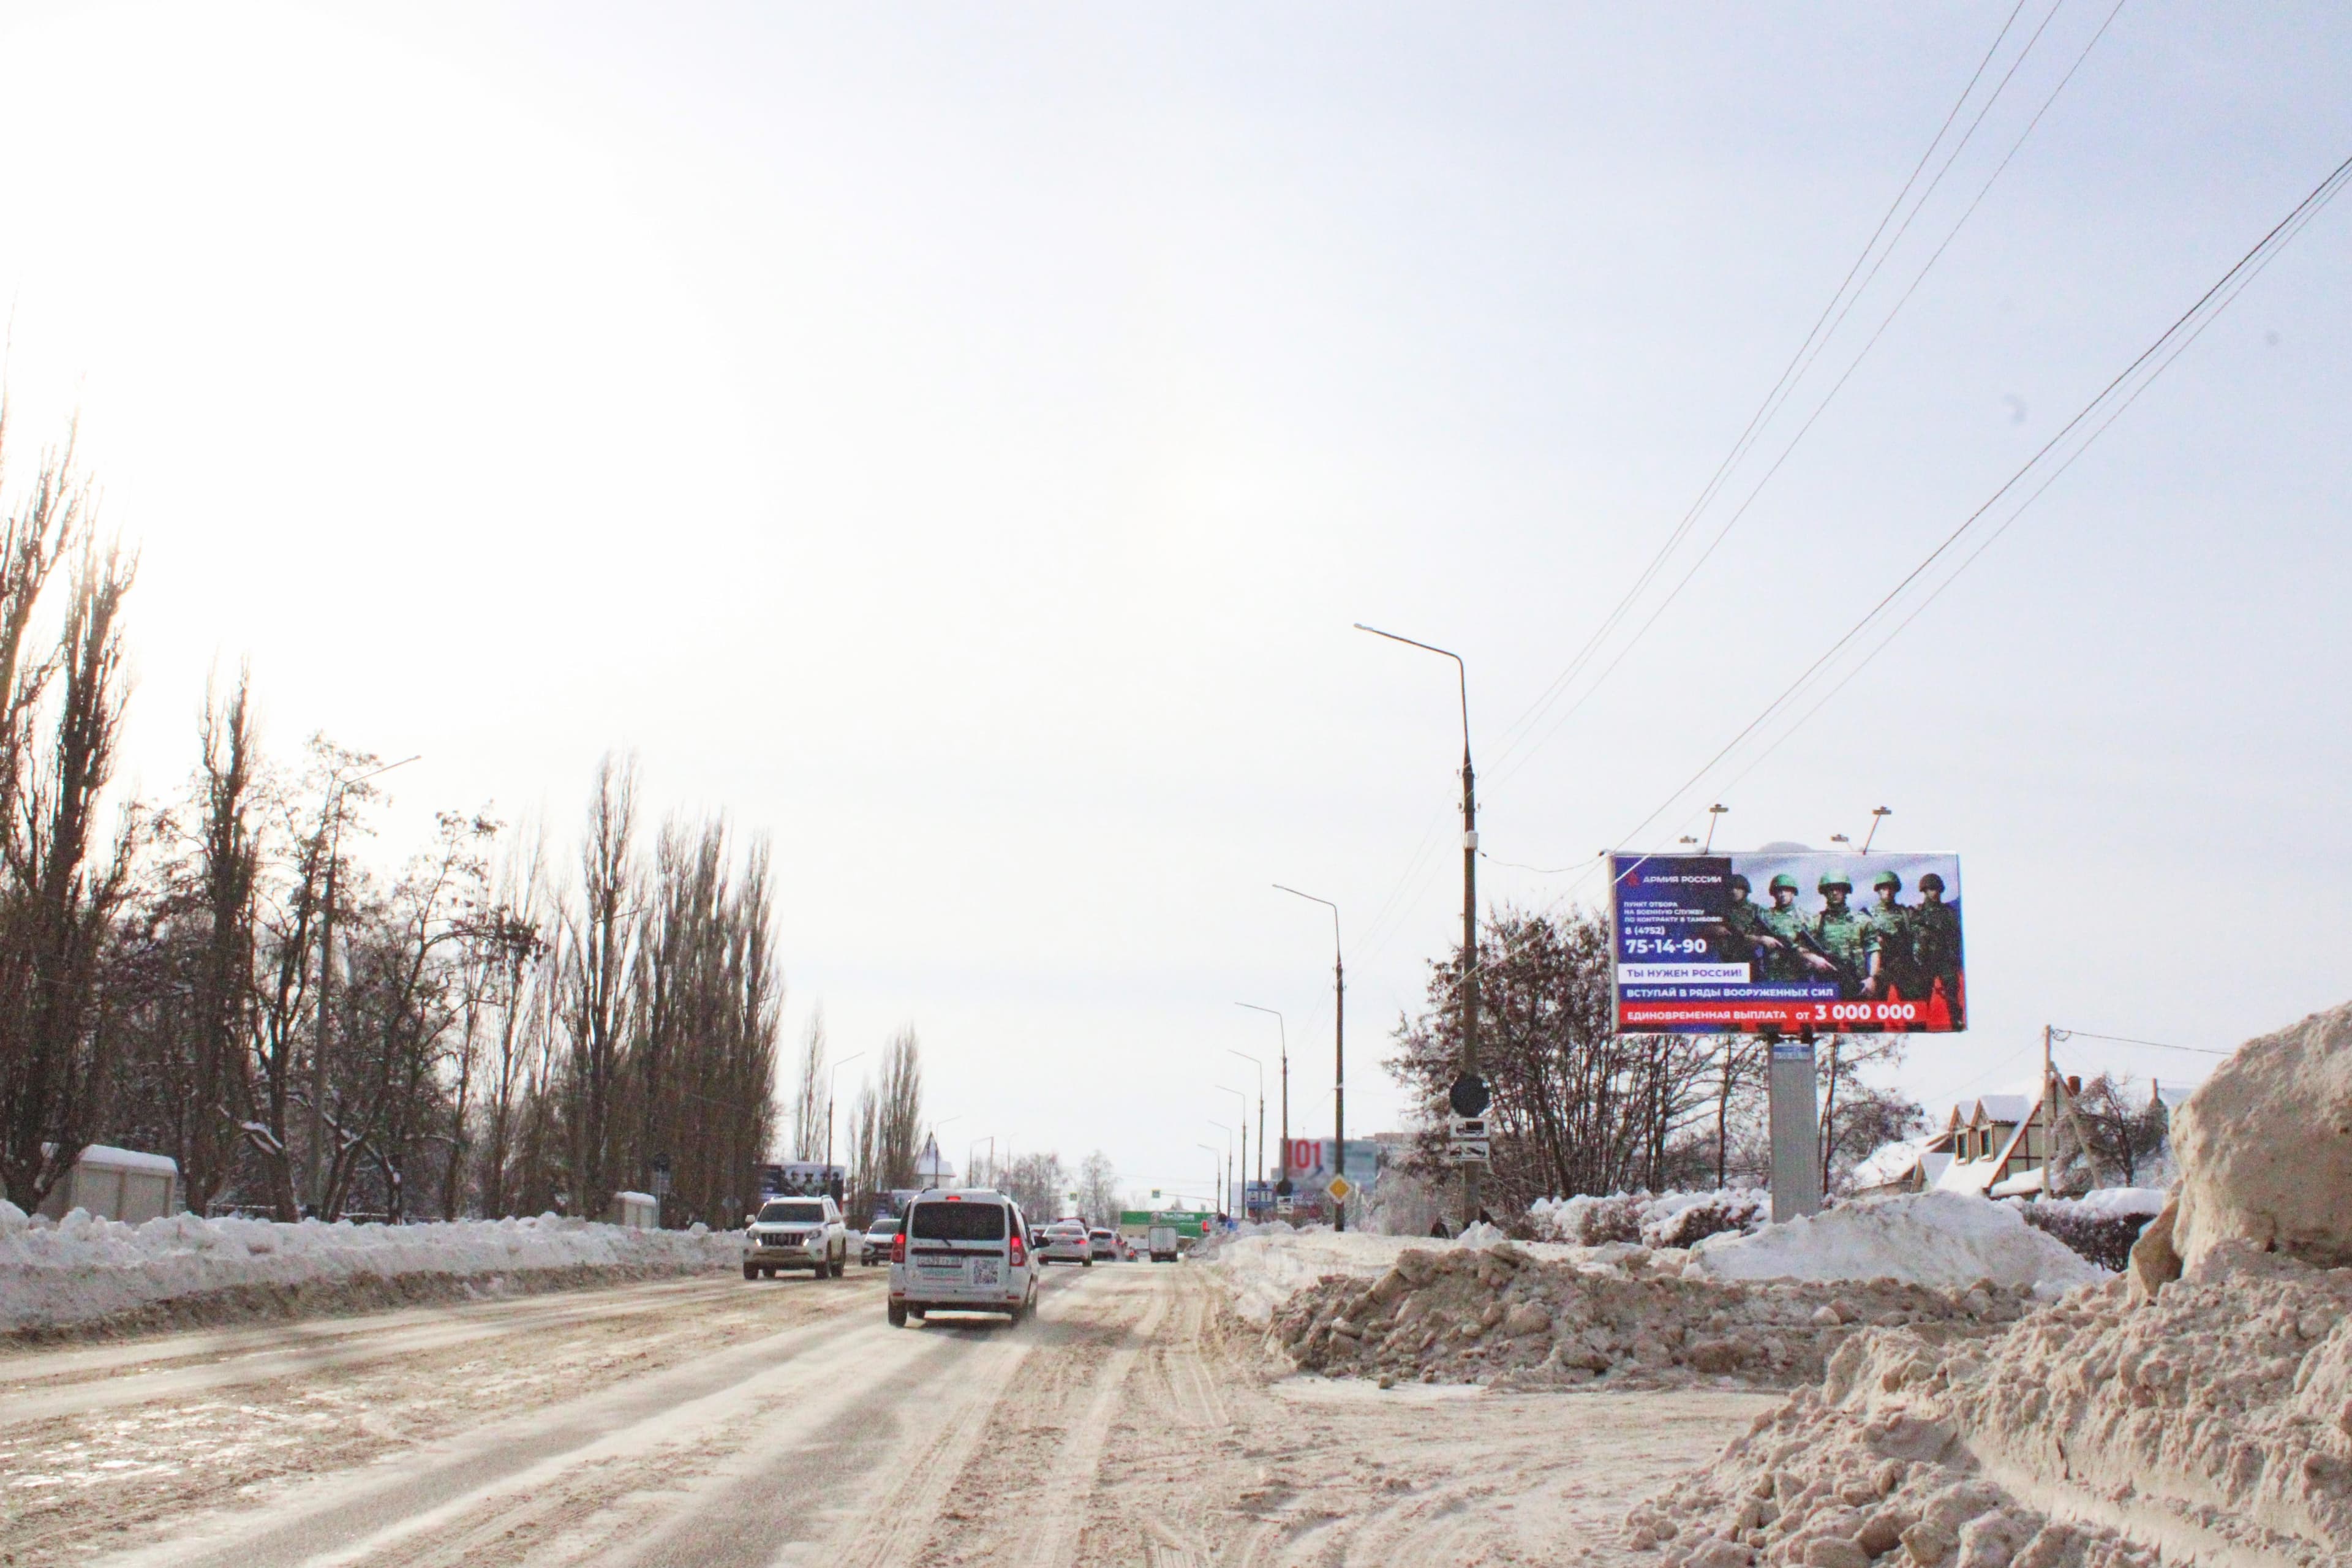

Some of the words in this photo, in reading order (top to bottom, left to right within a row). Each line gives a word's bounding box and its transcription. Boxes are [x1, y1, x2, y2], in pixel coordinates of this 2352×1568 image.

[1634, 926, 1665, 935] (4752)
[1626, 938, 1706, 954] 75-14-90
[1627, 987, 1676, 998] ВСТУПАЙ
[1689, 989, 1721, 998] РЯДЫ
[1724, 989, 1809, 997] ВООРУЖЕННЫХ
[1811, 988, 1834, 997] СИЛ
[1627, 1011, 1730, 1020] ЕДИНОВРЕМЕННАЯ
[1733, 1011, 1787, 1020] ВЫПЛАТА
[1815, 1005, 1826, 1020] 3
[1832, 1005, 1871, 1019] 000
[1877, 1005, 1915, 1019] 000
